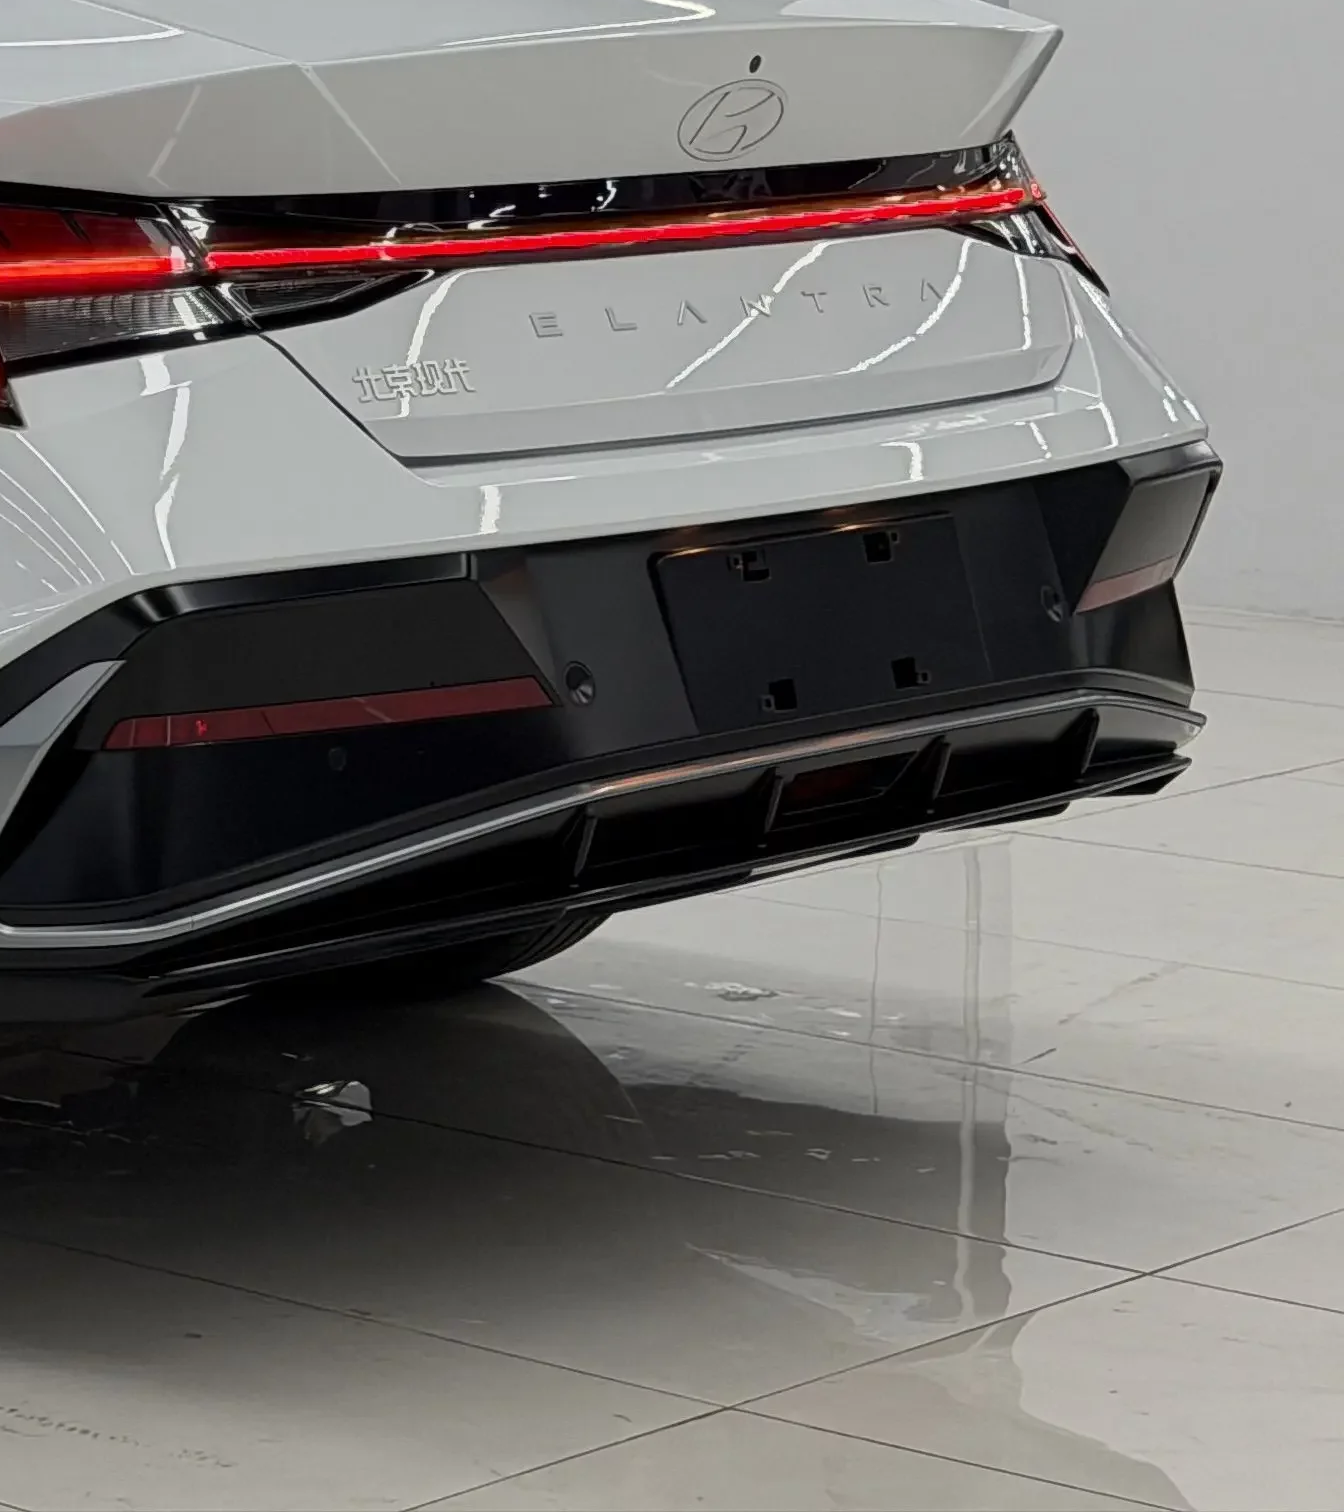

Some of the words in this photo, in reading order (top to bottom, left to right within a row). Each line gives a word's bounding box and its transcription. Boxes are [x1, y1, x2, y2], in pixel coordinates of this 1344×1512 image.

[527, 278, 944, 338] ELANTRA
[352, 357, 477, 403] 北京现代
